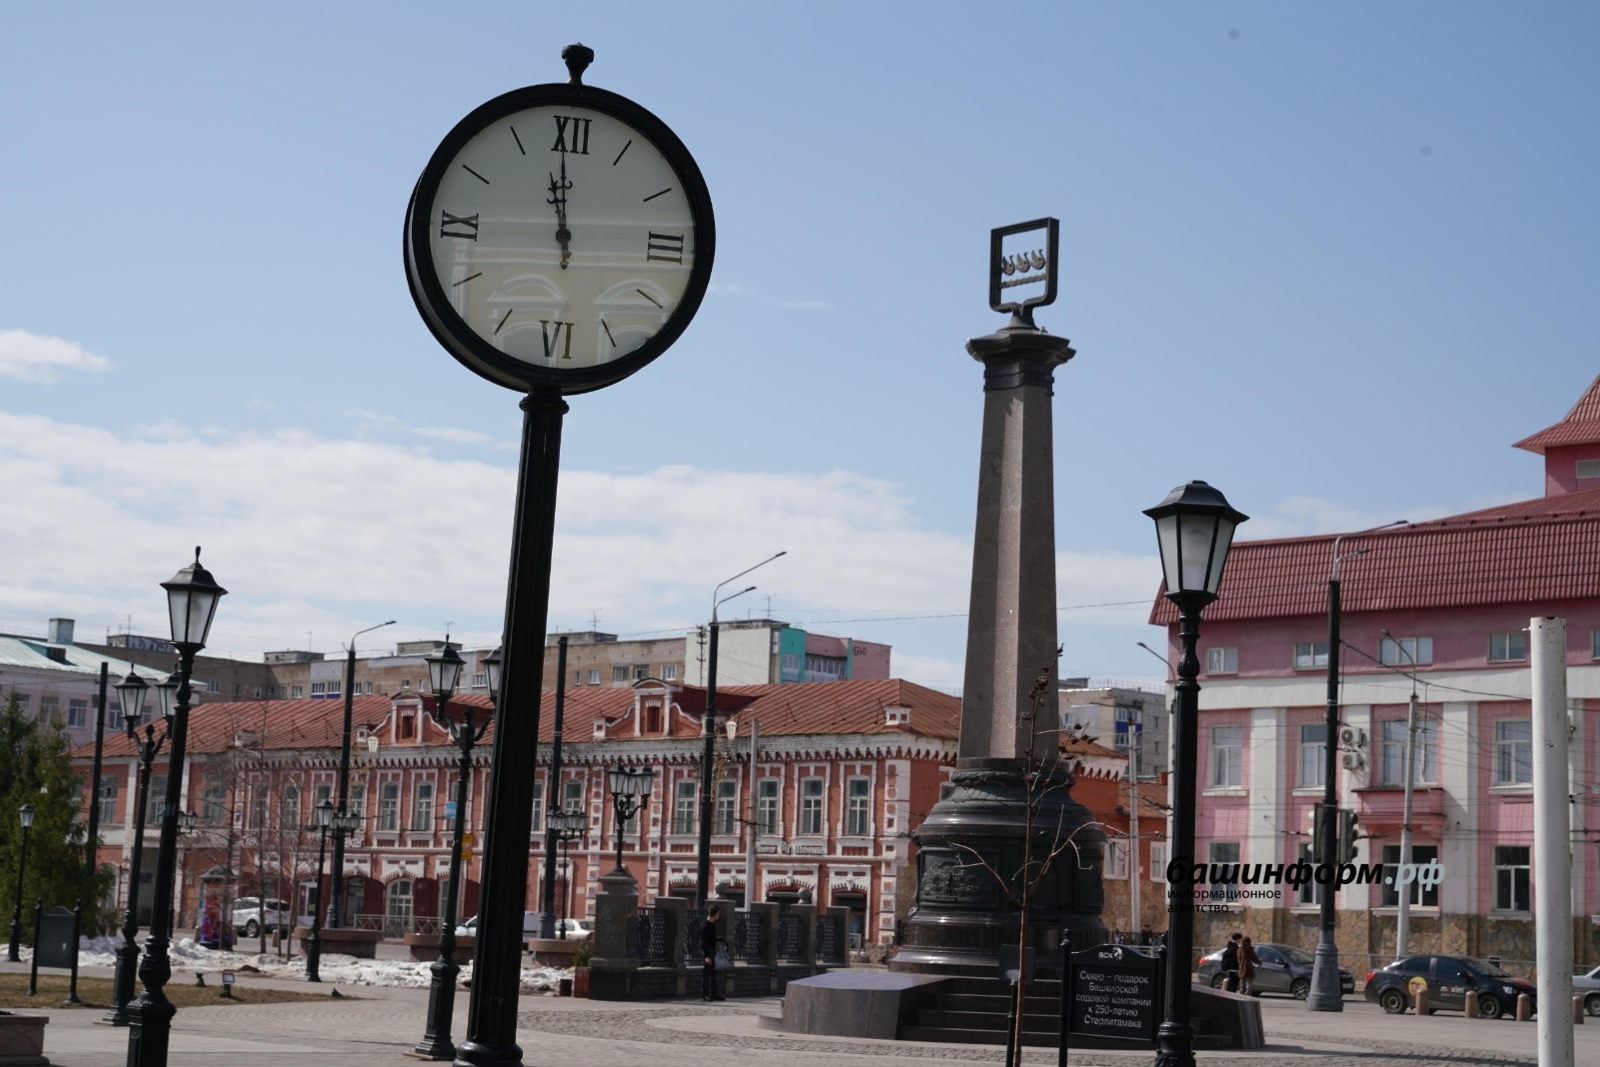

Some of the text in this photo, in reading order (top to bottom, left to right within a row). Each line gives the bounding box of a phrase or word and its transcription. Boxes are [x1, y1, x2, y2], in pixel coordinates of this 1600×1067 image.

[550, 115, 593, 155] XII
[440, 209, 480, 243] IX
[646, 230, 685, 266] III
[539, 319, 575, 360] VI
[1080, 970, 1105, 982] Сквер
[1114, 974, 1148, 984] подарок
[1088, 982, 1139, 994] Башкирской
[1075, 993, 1152, 1006] содовой компании
[1095, 1004, 1138, 1016] 250-летию
[1084, 1014, 1142, 1028] Стерлитамака
